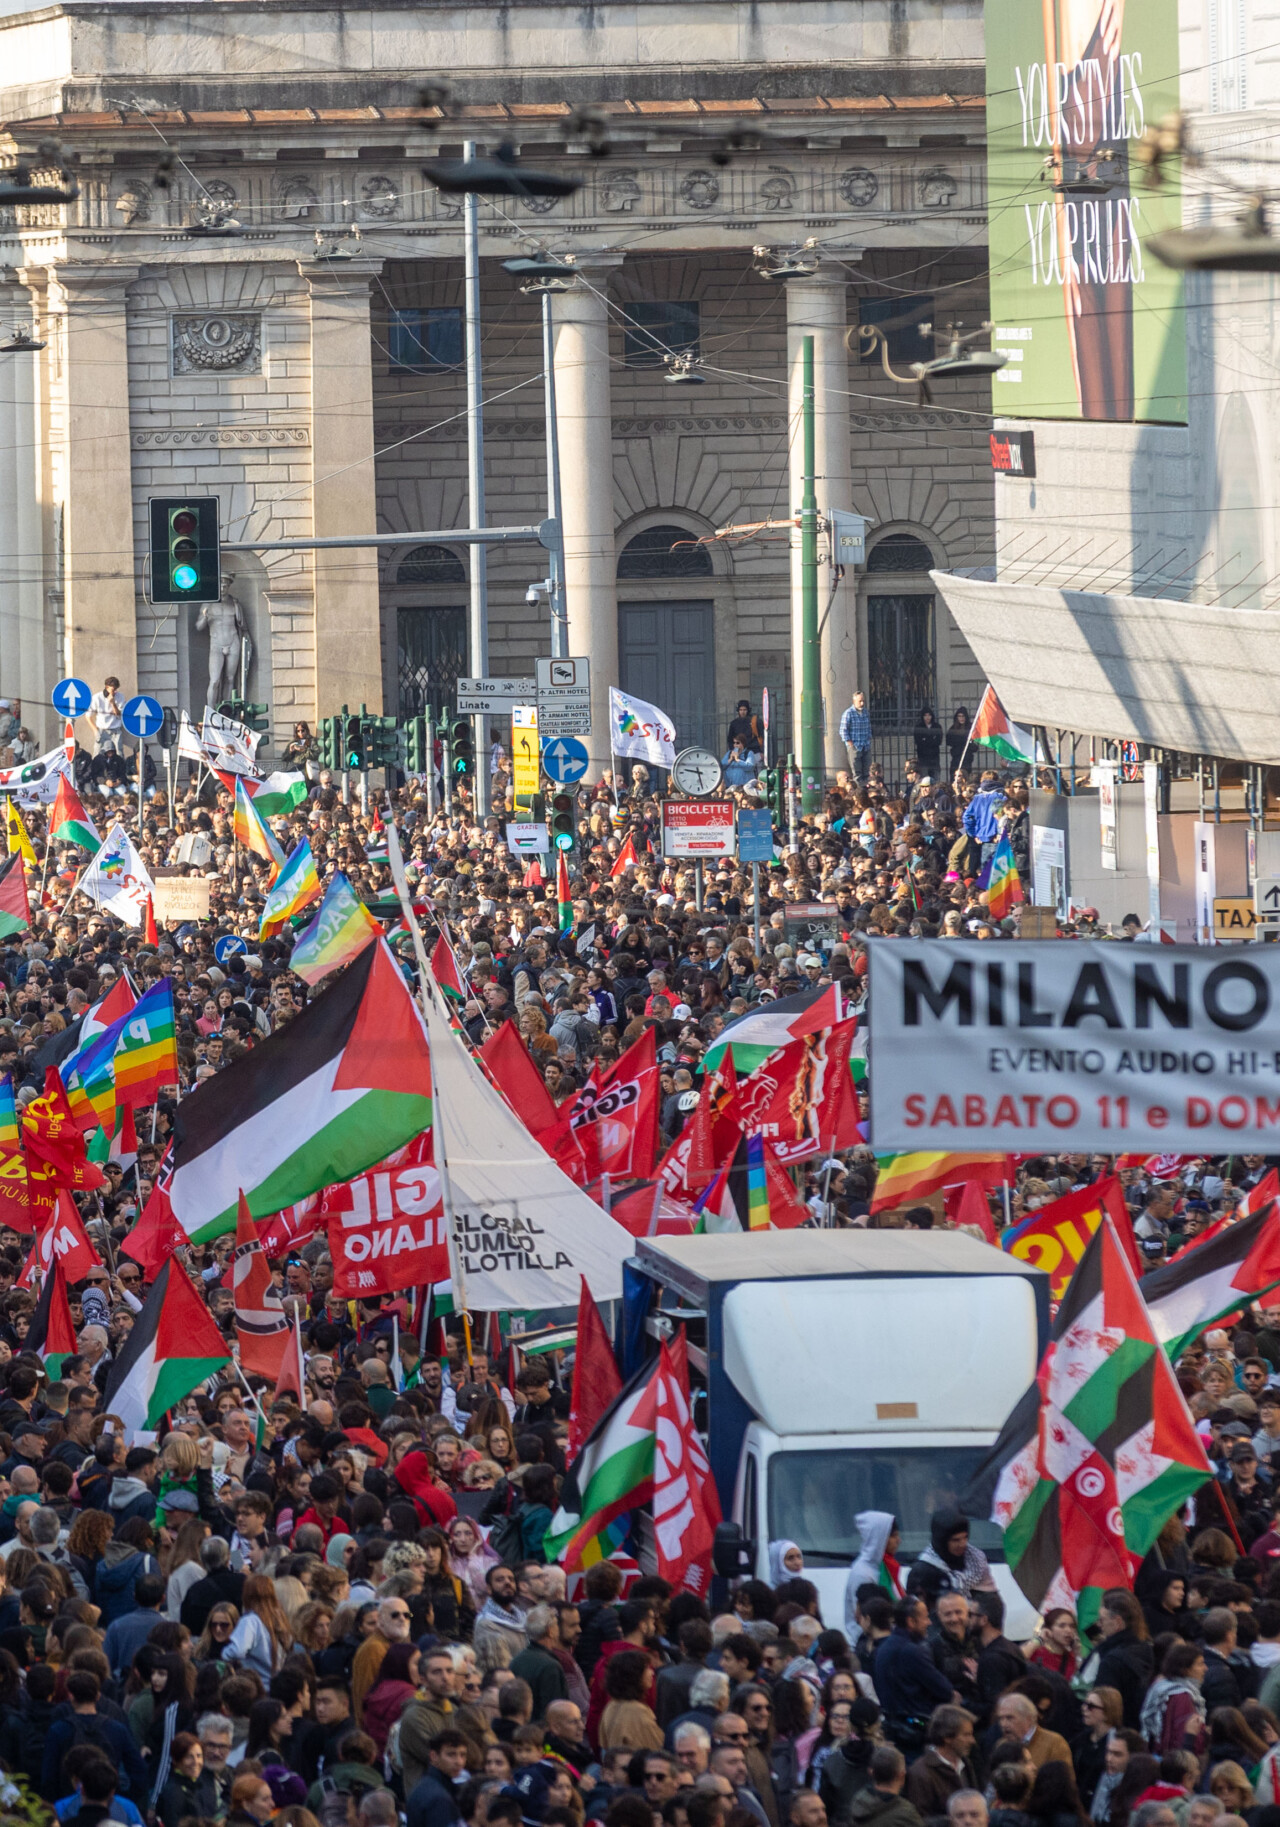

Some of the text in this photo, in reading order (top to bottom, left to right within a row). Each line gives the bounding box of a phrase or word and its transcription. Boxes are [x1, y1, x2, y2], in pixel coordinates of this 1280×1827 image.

[1015, 52, 1148, 147] YOUR STYLES.
[1025, 197, 1145, 286] YOUR RULES.
[460, 682, 496, 691] S. Siro
[460, 701, 490, 710] Linate
[668, 804, 729, 814] BICICLETTE
[902, 958, 1271, 1032] MILANO
[989, 1047, 1106, 1075] EVENTO
[1116, 1049, 1216, 1075] AUDIO
[903, 1093, 1079, 1129] SABATO
[1096, 1094, 1130, 1129] 11
[1145, 1102, 1170, 1129] e
